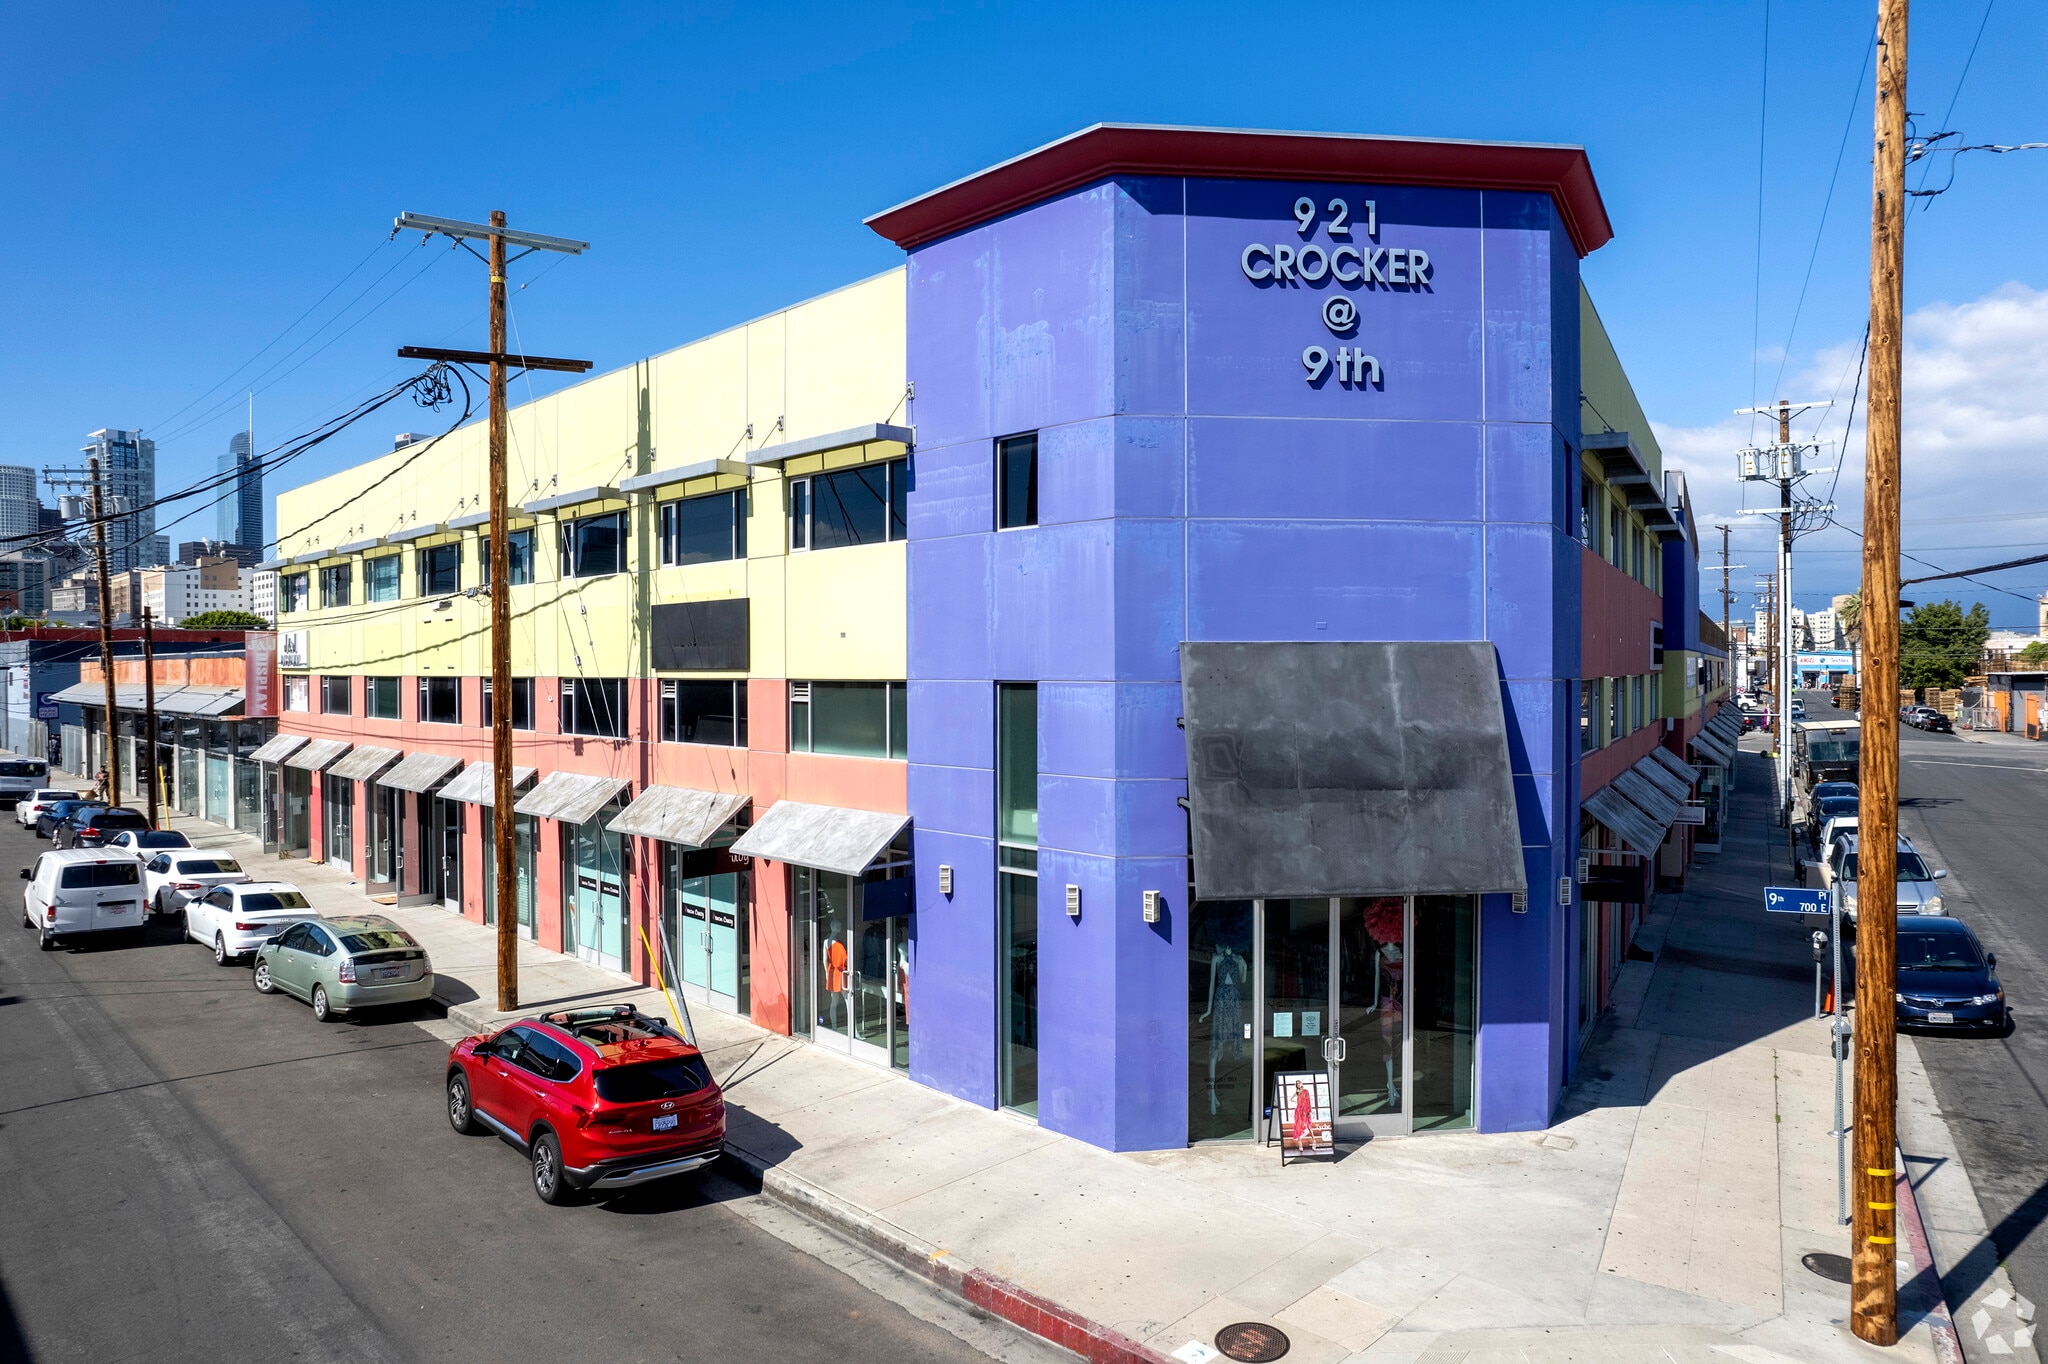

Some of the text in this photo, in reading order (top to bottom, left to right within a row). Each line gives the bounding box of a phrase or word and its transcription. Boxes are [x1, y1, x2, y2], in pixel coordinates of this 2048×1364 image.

[1294, 196, 1376, 235] 921
[1241, 243, 1430, 284] CROCKER
[1322, 295, 1357, 331] @
[1302, 345, 1380, 383] 9th
[256, 652, 268, 711] DISPLAY
[1799, 903, 1827, 912] 700 E
